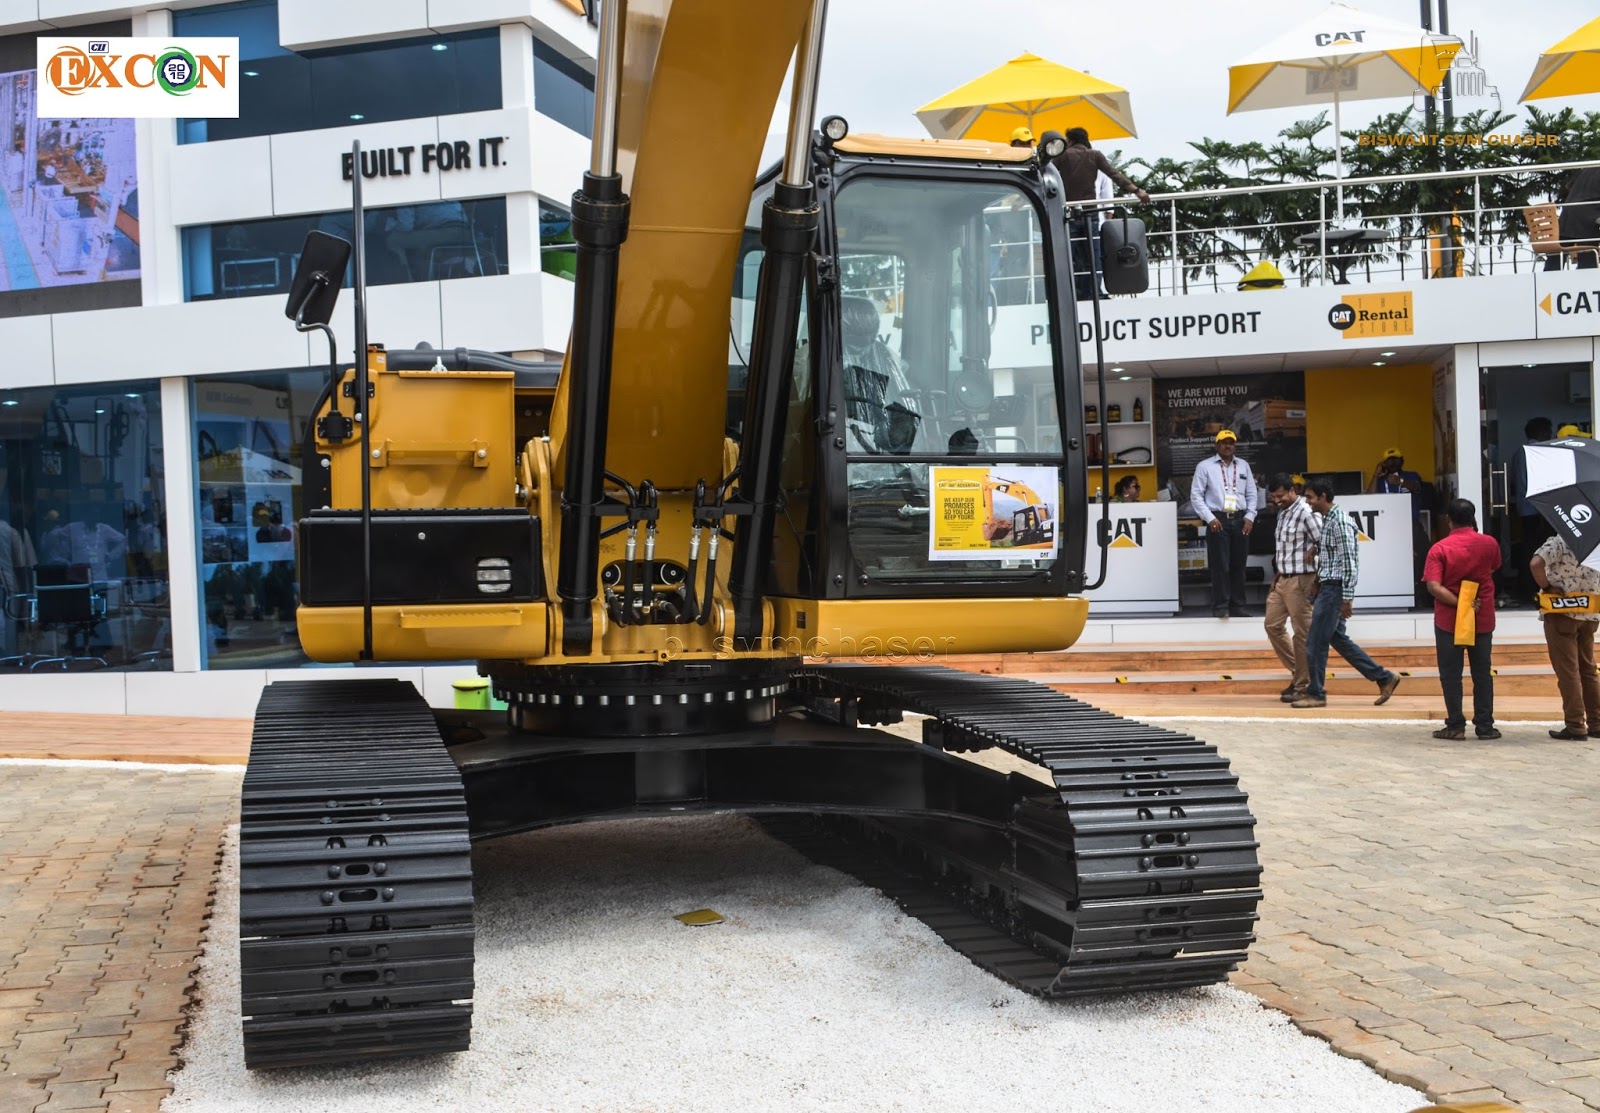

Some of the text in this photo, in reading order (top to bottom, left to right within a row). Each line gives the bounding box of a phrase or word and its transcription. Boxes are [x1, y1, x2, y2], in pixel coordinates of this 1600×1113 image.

[1315, 30, 1366, 47] CAT
[421, 142, 471, 173] FOR
[1332, 307, 1409, 324] CAT Rental
[1031, 311, 1262, 346] PDUCT SUPPORT
[1168, 385, 1248, 398] WE ARE WITH YOU
[1168, 396, 1227, 408] EVERYWHERE
[1554, 504, 1582, 538] INESIS
[1096, 517, 1147, 547] CAT
[1552, 596, 1588, 608] JCB
